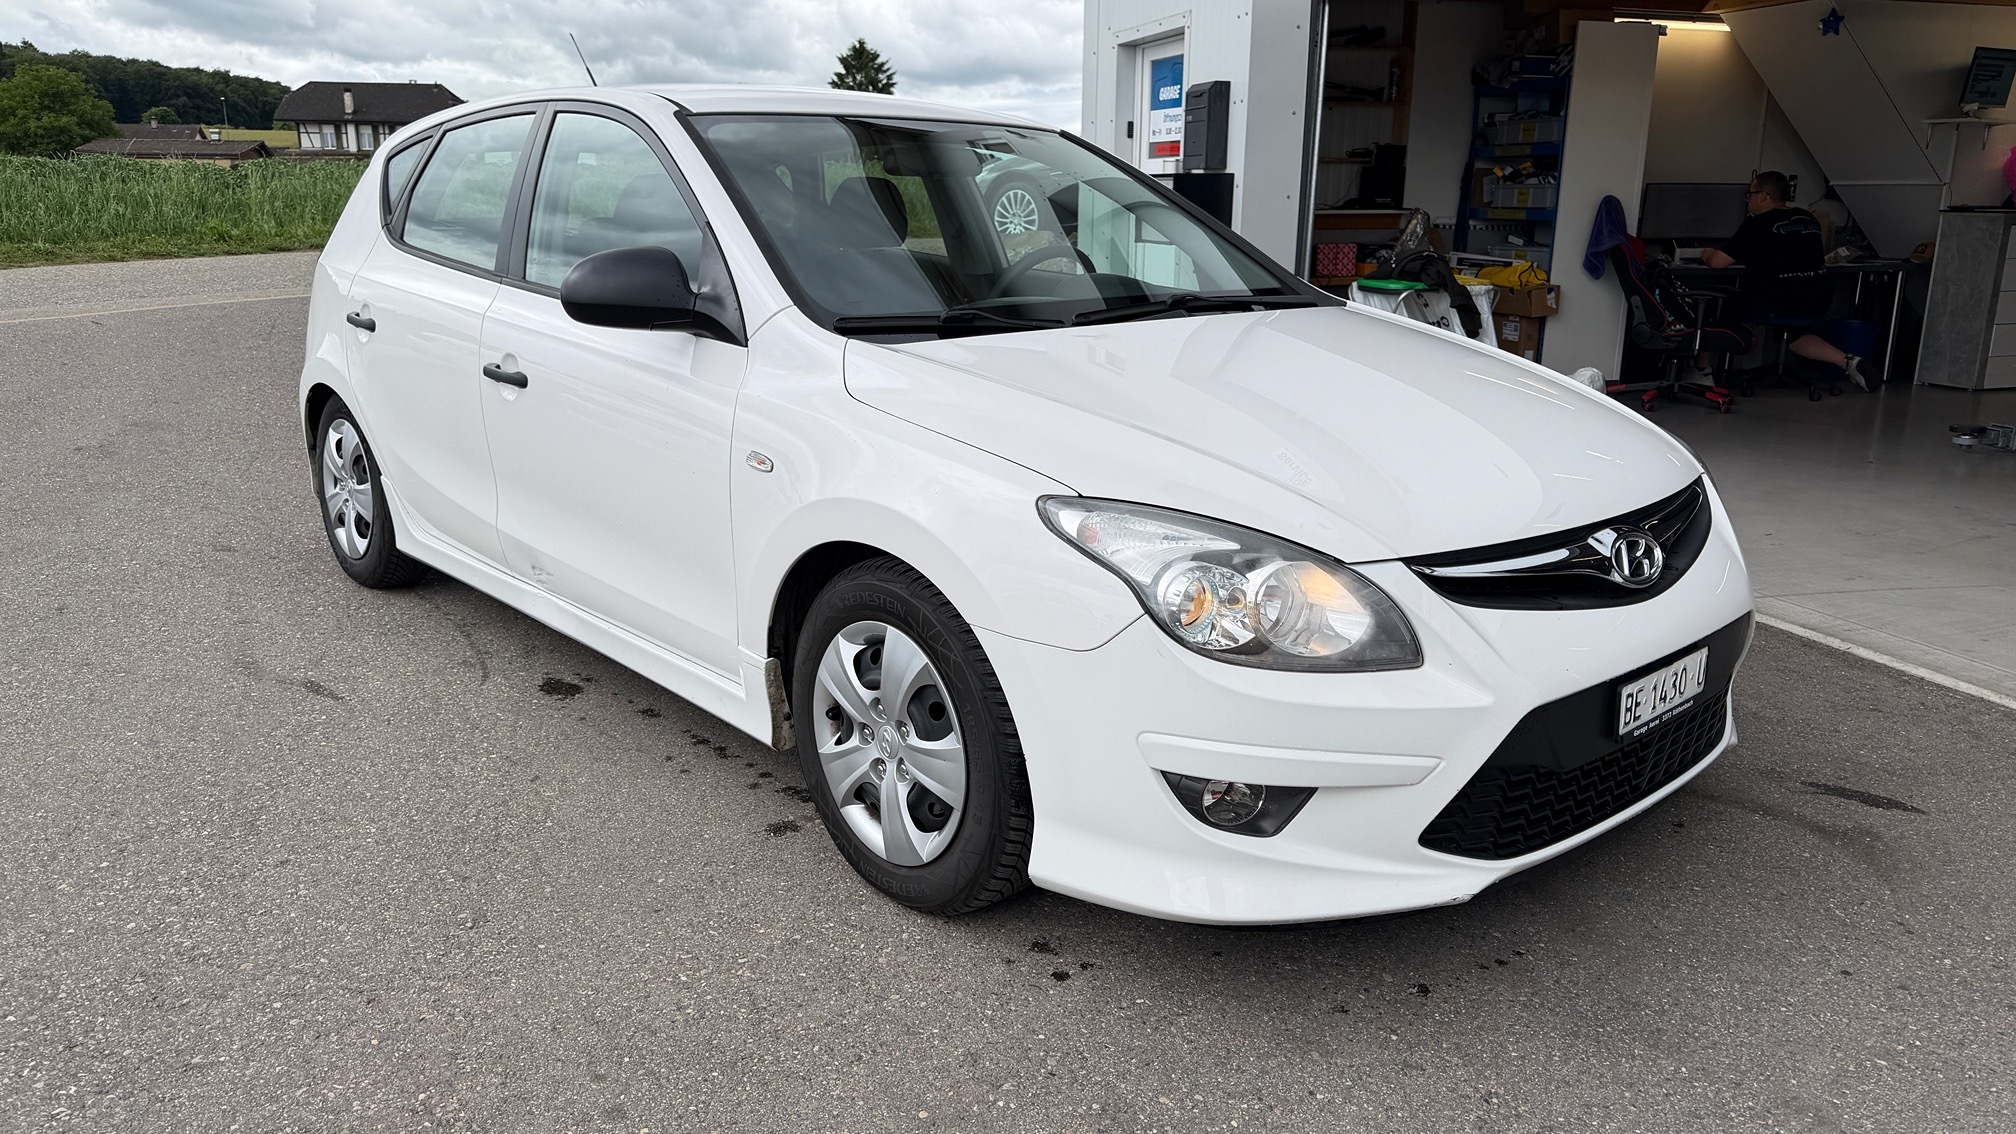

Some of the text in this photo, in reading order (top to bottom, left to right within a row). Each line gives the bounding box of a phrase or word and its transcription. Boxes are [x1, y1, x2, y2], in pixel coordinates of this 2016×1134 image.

[1159, 84, 1181, 101] GARAGE
[834, 591, 906, 618] VREDESTEIN
[1622, 685, 1645, 727] BE
[1650, 663, 1687, 714] 1430
[1633, 725, 1648, 737] Garage
[858, 860, 931, 897] VREDESTEIN
